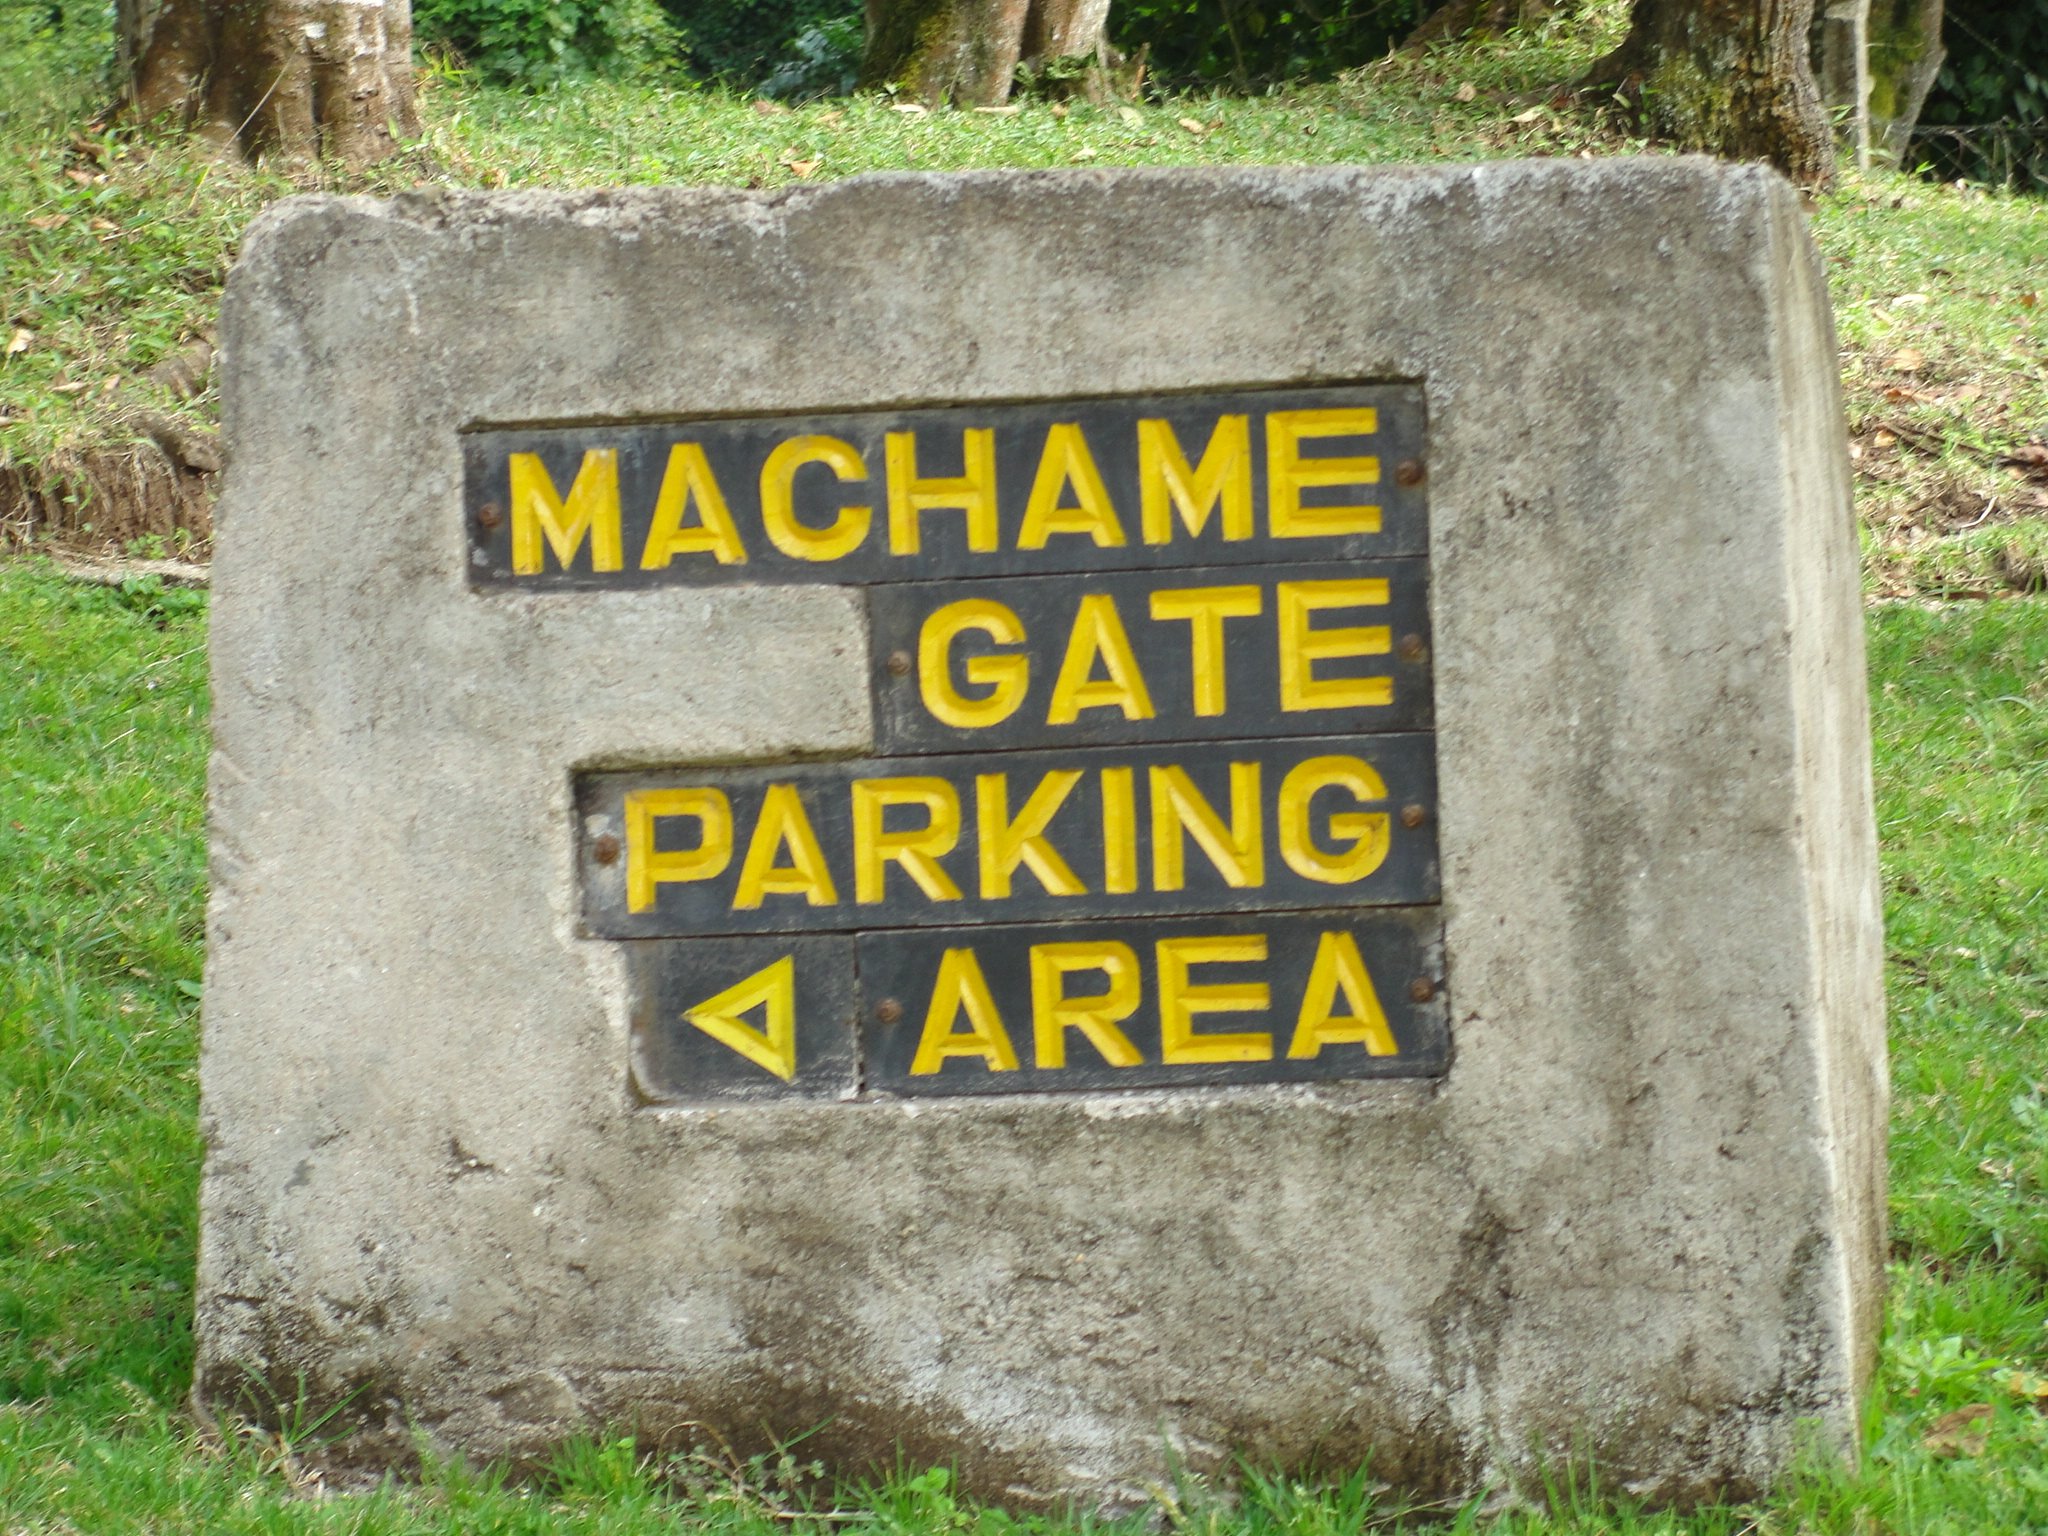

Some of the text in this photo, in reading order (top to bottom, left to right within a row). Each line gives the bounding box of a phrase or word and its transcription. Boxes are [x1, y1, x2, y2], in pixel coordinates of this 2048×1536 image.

[509, 407, 1383, 574] MACHAME
[916, 577, 1394, 729] GATE
[624, 754, 1391, 912] PARKING
[911, 931, 1399, 1075] AREA
